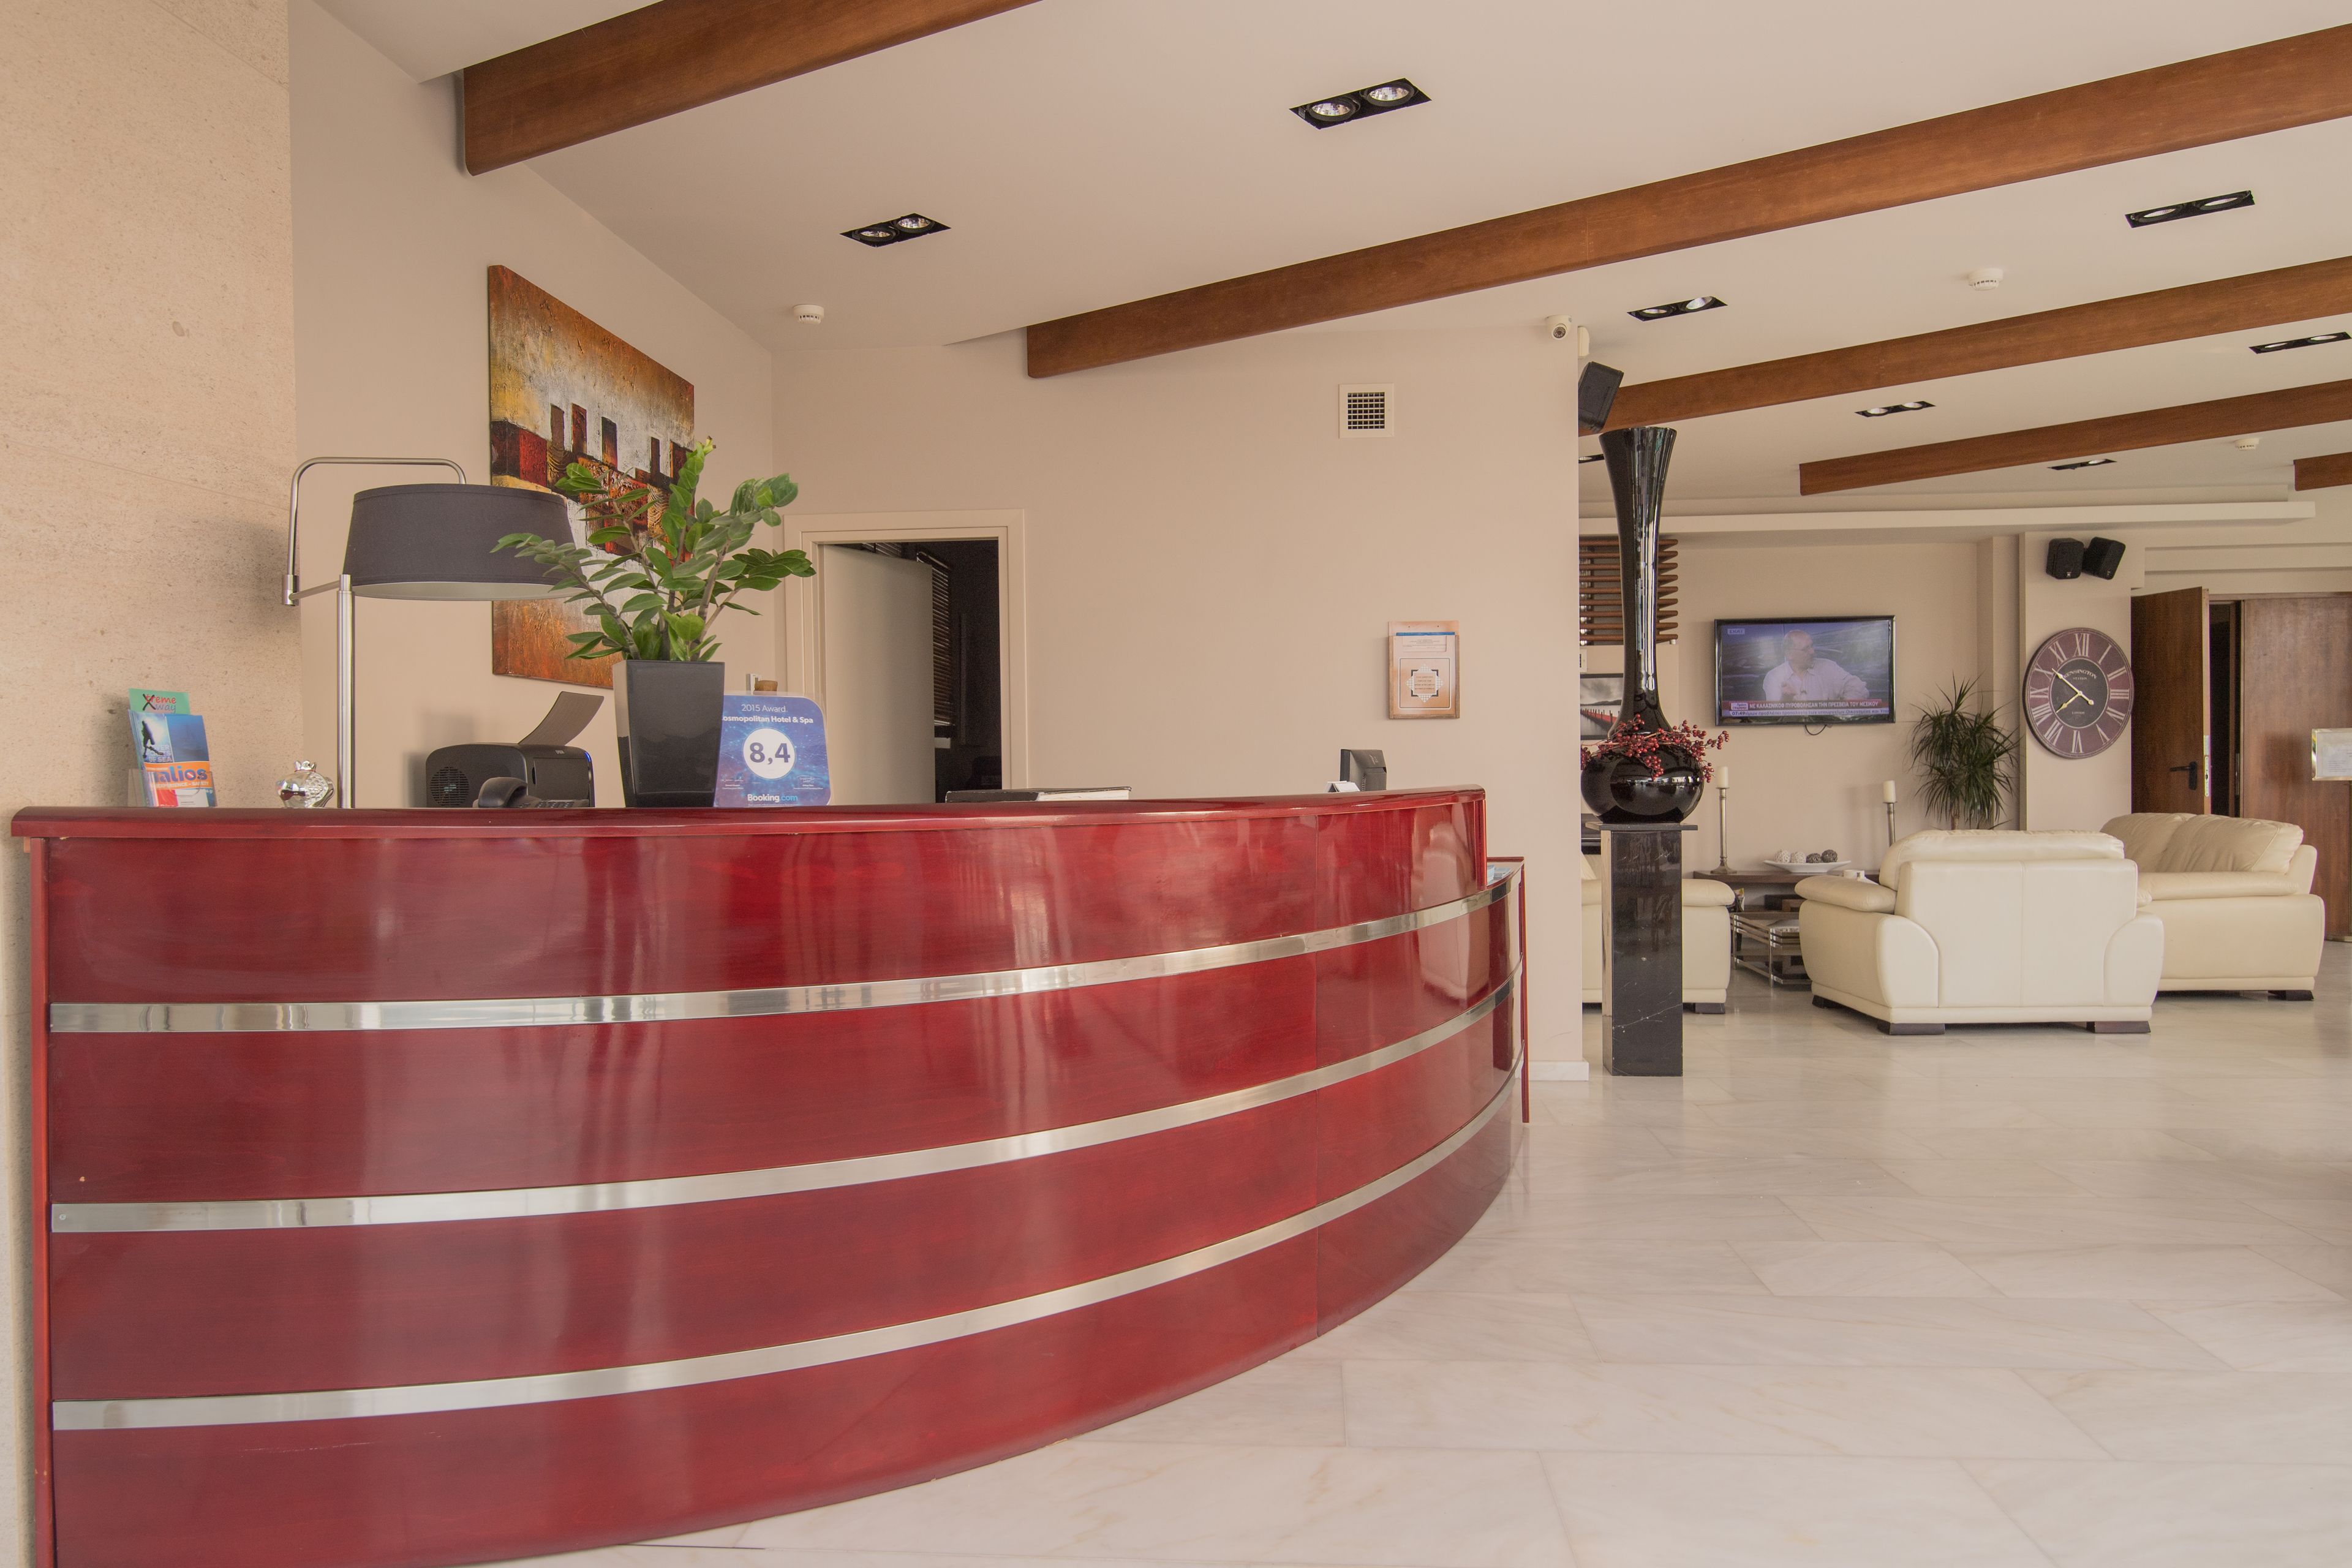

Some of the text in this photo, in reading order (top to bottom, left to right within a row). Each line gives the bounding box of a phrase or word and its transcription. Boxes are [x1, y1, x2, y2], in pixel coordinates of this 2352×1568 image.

[2073, 633, 2090, 657] XII
[2063, 669, 2098, 679] KENSINGTON
[2107, 666, 2127, 681] II
[143, 693, 176, 710] Xtreme
[2109, 688, 2130, 700] III
[156, 704, 176, 714] way
[722, 715, 770, 724] osmopolitan
[2071, 729, 2084, 754] VI
[749, 742, 791, 765] 8,4
